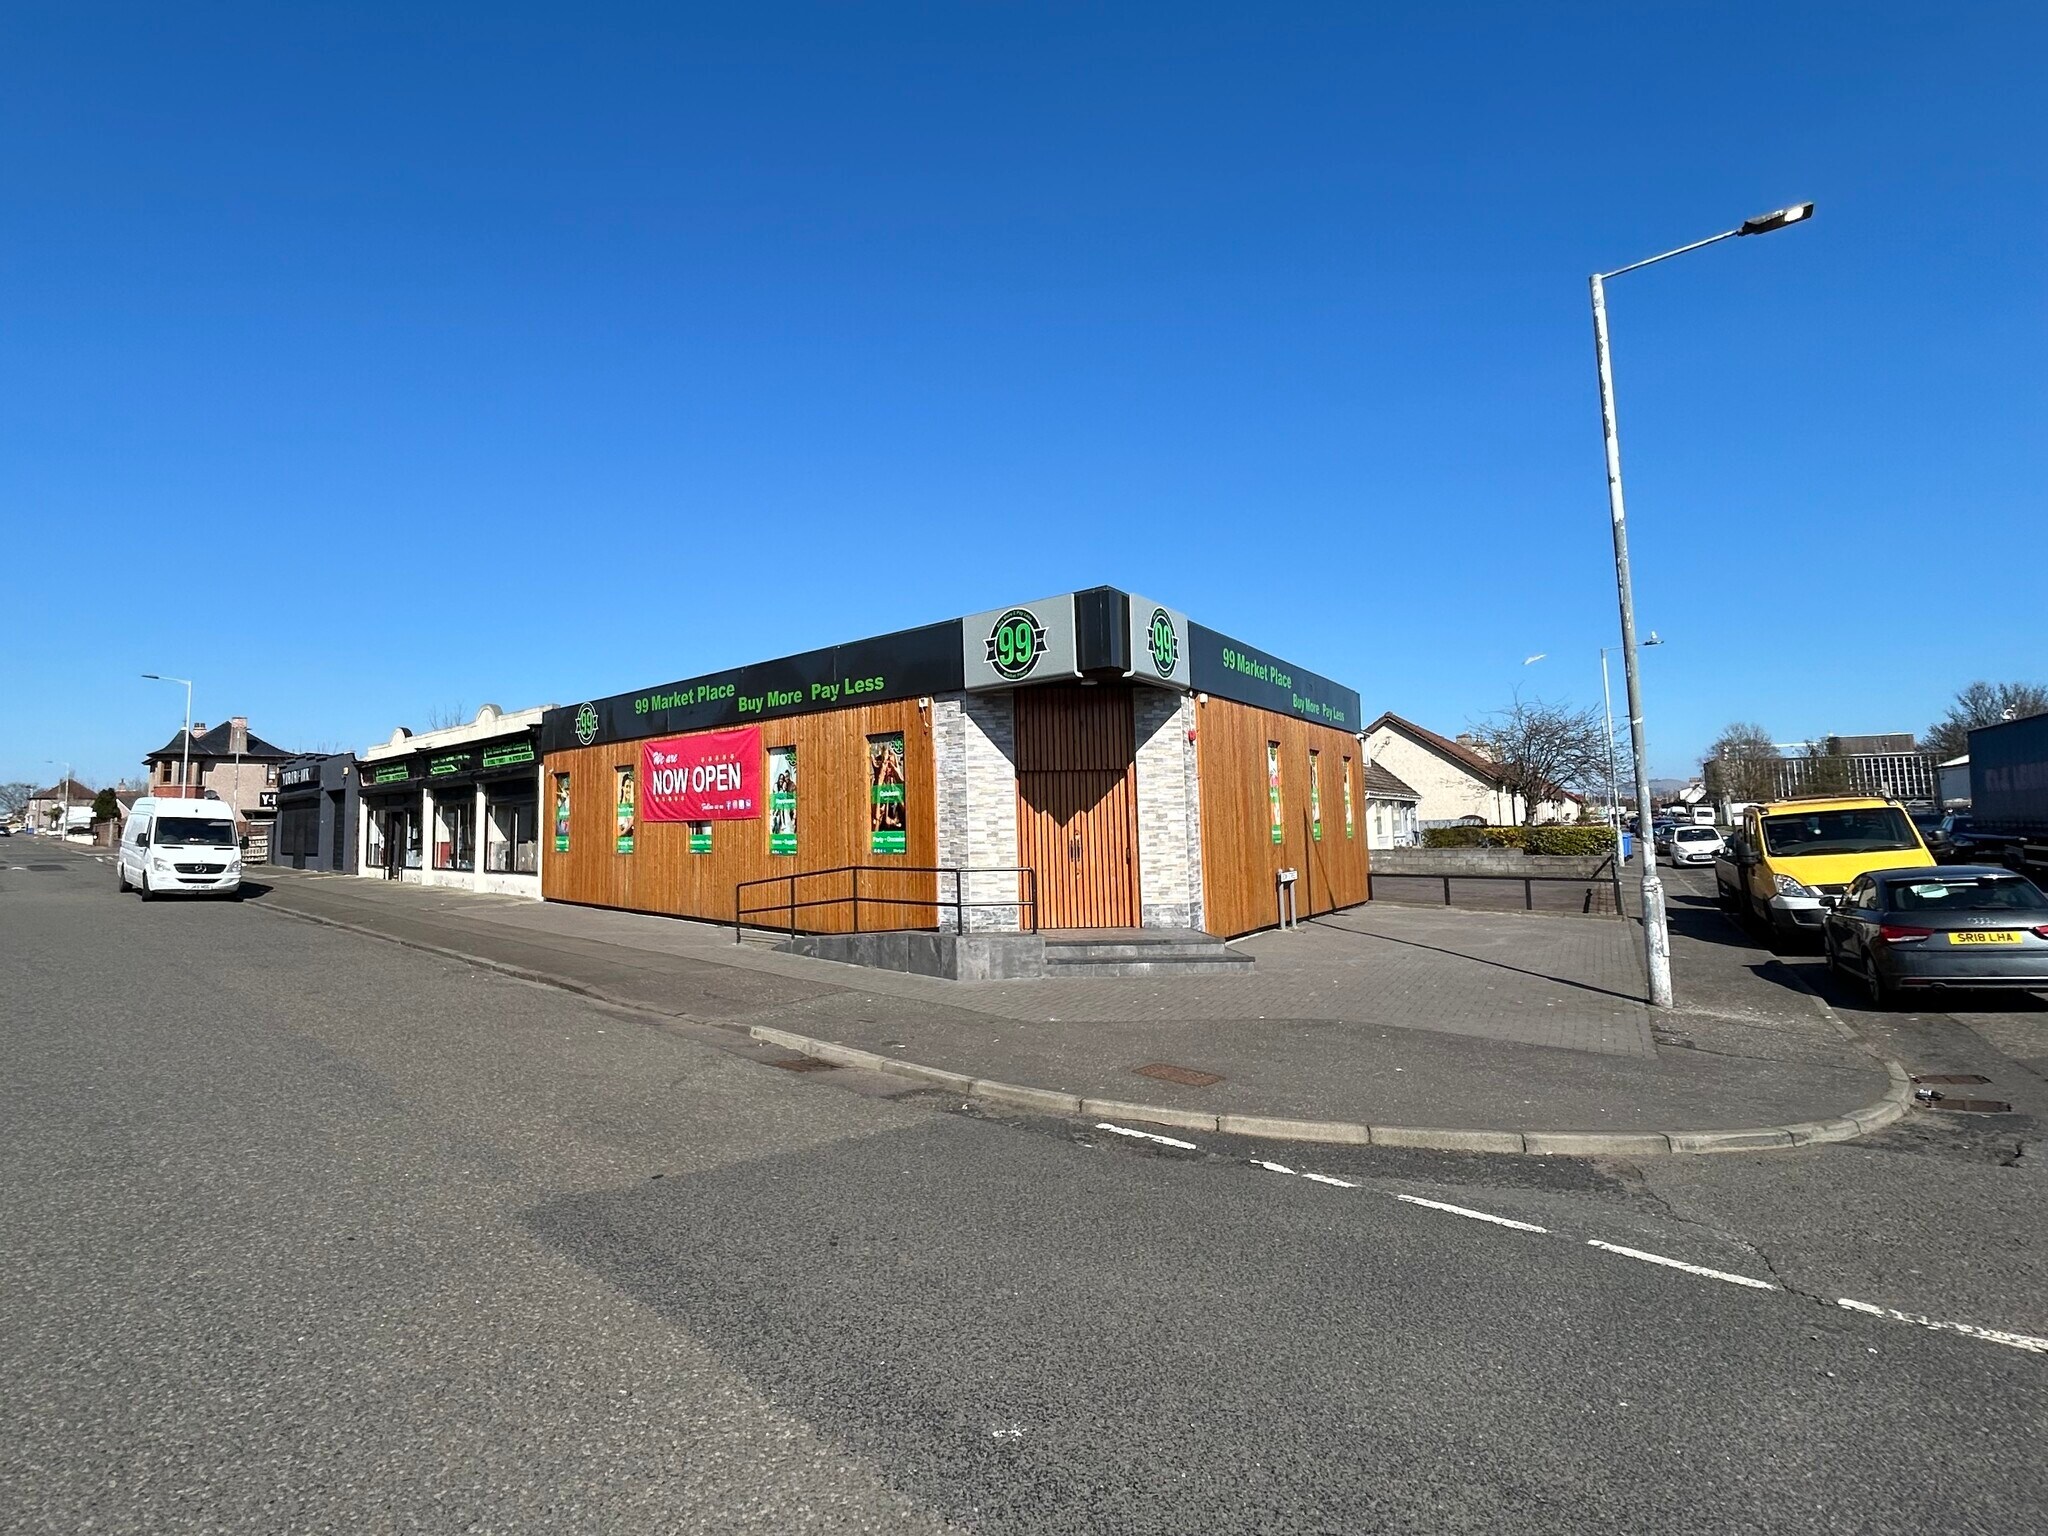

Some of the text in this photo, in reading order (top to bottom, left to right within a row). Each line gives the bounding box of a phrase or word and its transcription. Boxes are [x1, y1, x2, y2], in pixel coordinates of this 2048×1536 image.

[999, 622, 1031, 665] 99
[1154, 621, 1172, 664] 99
[1222, 647, 1292, 689] 99 Market Place
[635, 683, 736, 715] 99 Market Place
[738, 676, 885, 714] Buy More Pay Less
[1293, 693, 1345, 722] Buy More Pay Less
[581, 711, 593, 735] 99
[652, 751, 678, 765] We are
[652, 762, 741, 795] NOW OPEN
[1957, 933, 2014, 942] SR18 LHA
